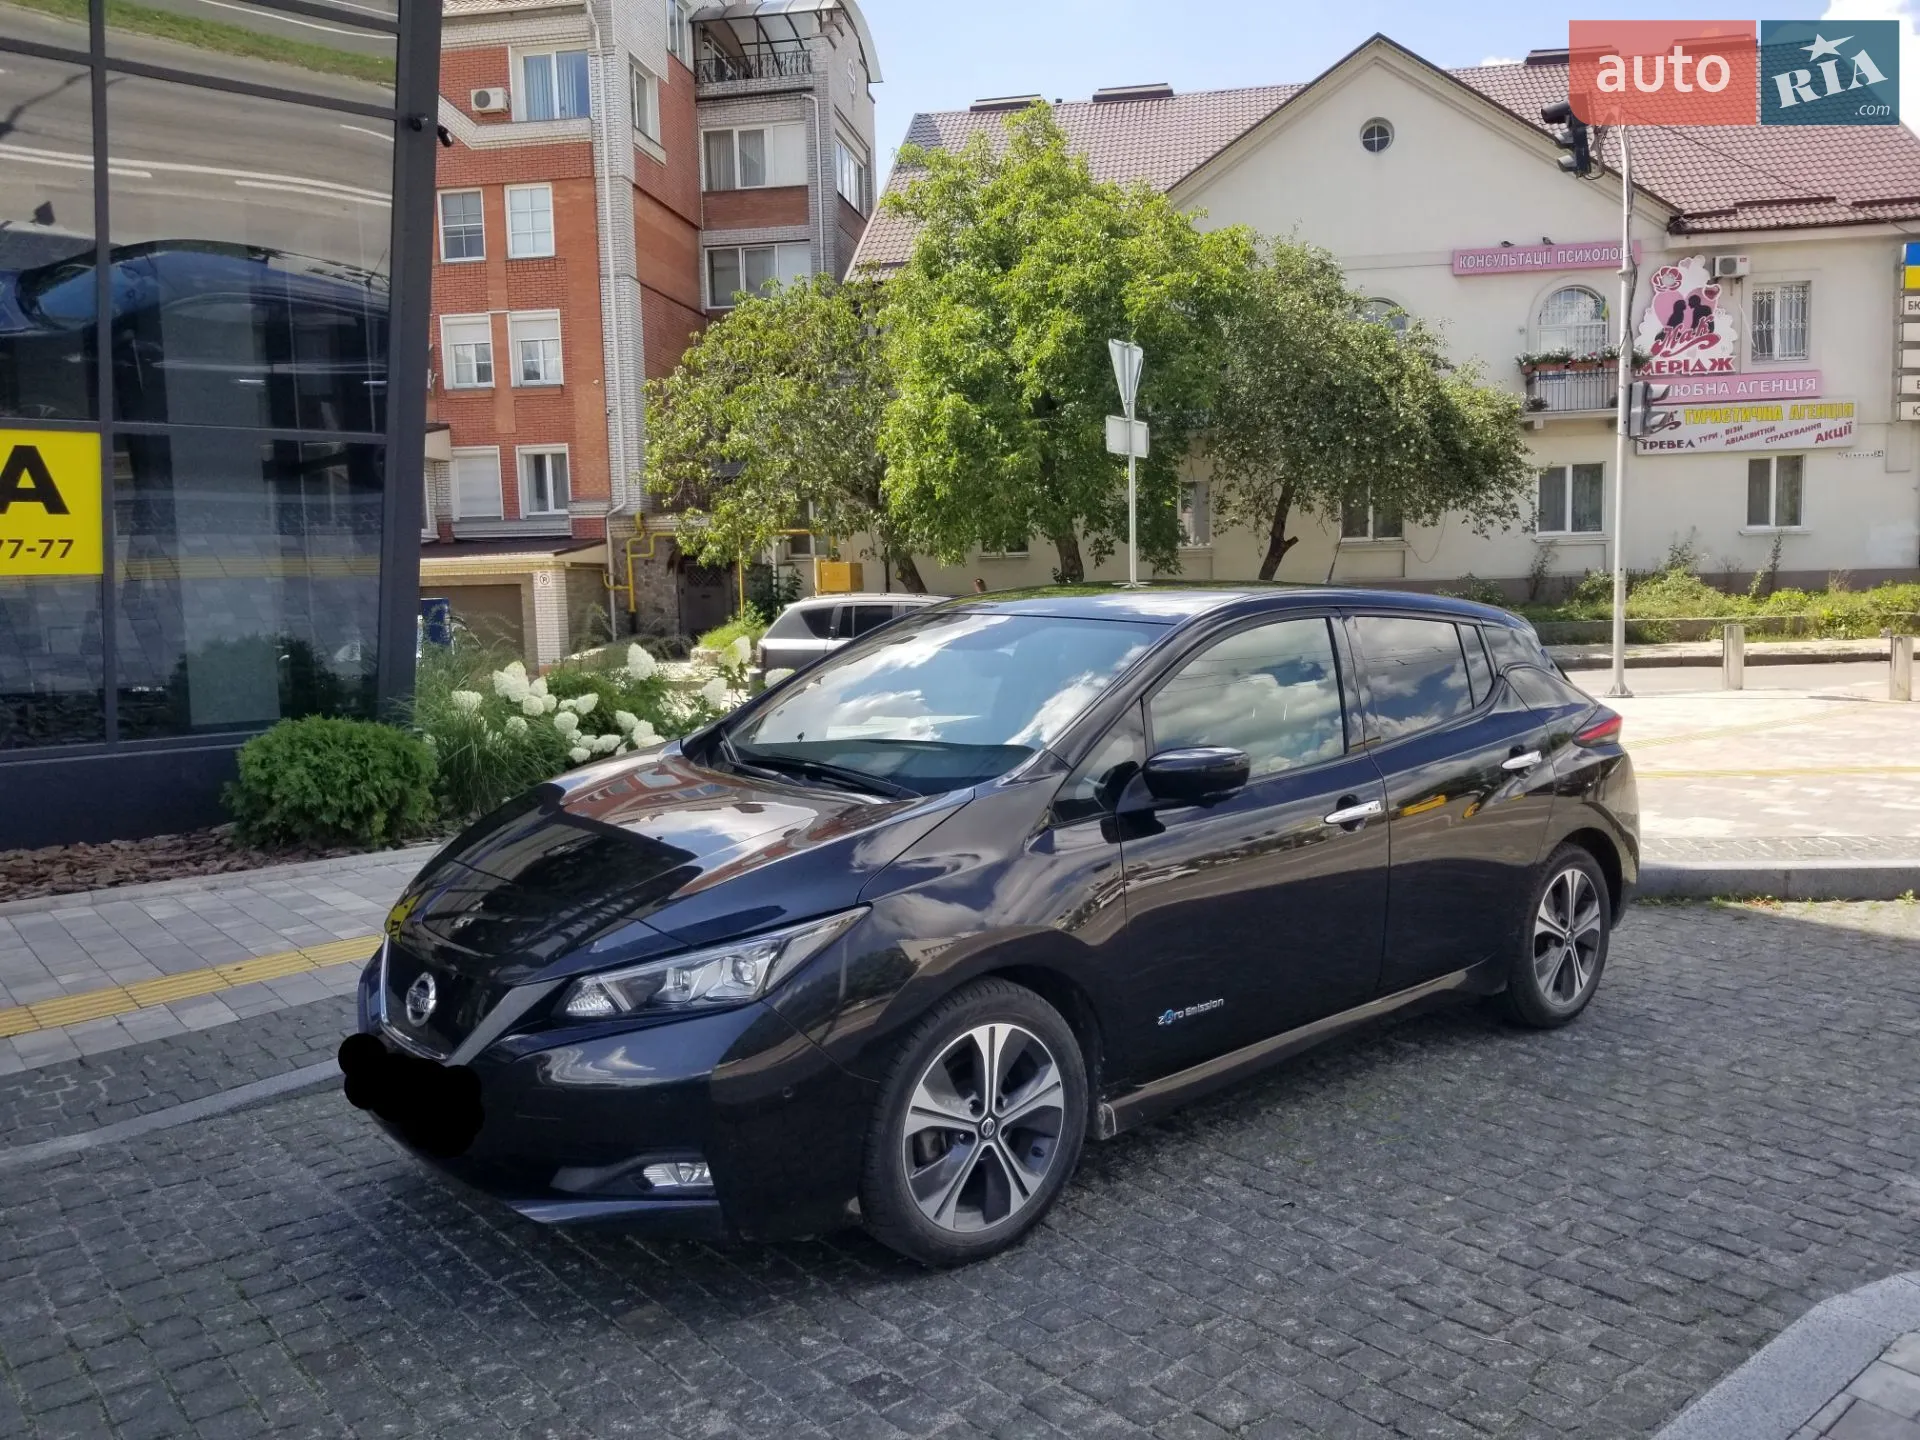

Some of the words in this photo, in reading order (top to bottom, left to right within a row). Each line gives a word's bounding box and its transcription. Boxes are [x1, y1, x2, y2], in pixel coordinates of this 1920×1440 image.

[1736, 377, 1817, 394] АГЕНЦІЯ
[1684, 405, 1784, 426] ТУРИСТИЧНА
[1788, 402, 1855, 421] АГЕНЦІЯ
[1765, 422, 1822, 444] СТРАХУВАННЯ
[1814, 421, 1853, 444] АКЦІЇ
[0, 539, 75, 559] 7-77
